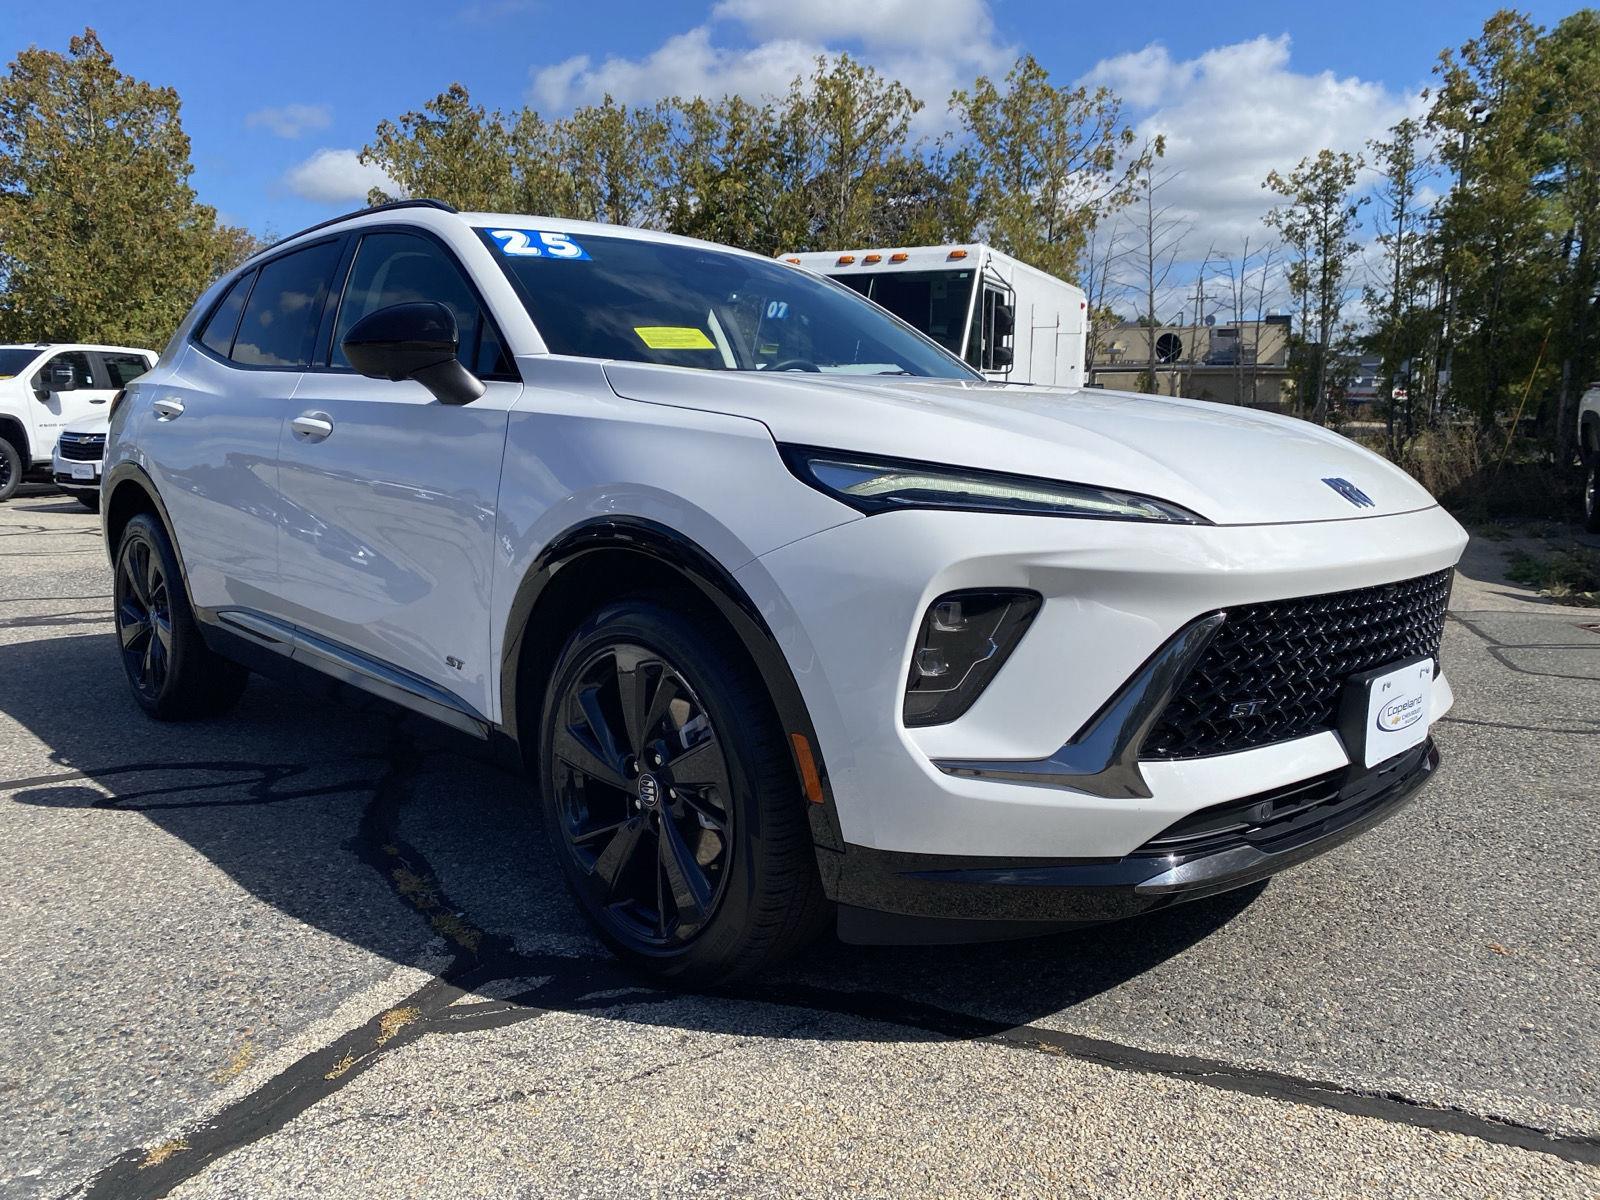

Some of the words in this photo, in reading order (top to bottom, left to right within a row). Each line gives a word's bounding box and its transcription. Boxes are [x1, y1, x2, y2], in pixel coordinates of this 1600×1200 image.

[491, 230, 582, 258] 25
[767, 301, 788, 318] 07
[445, 655, 465, 670] ST
[1229, 699, 1267, 719] ST
[1387, 694, 1422, 716] Copeland
